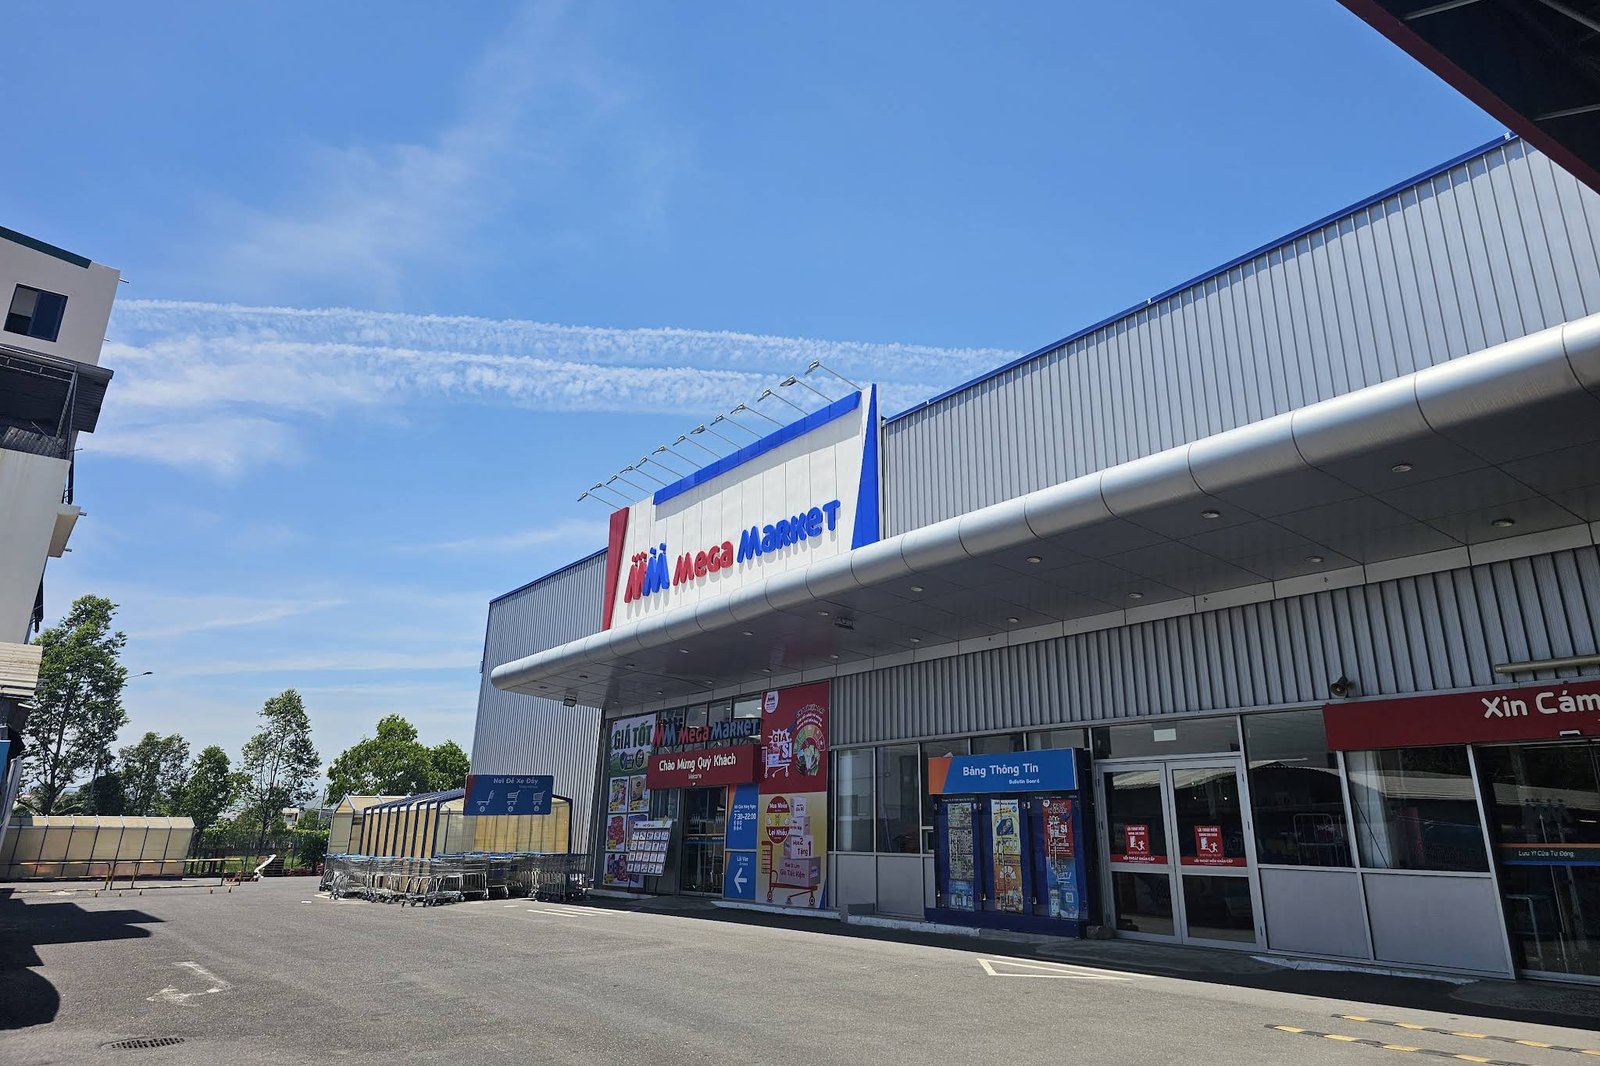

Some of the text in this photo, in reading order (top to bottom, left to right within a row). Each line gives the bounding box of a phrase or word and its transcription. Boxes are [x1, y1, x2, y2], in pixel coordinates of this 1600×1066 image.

[1480, 695, 1529, 719] Xin
[962, 763, 1039, 778] Bảng Thông Tin
